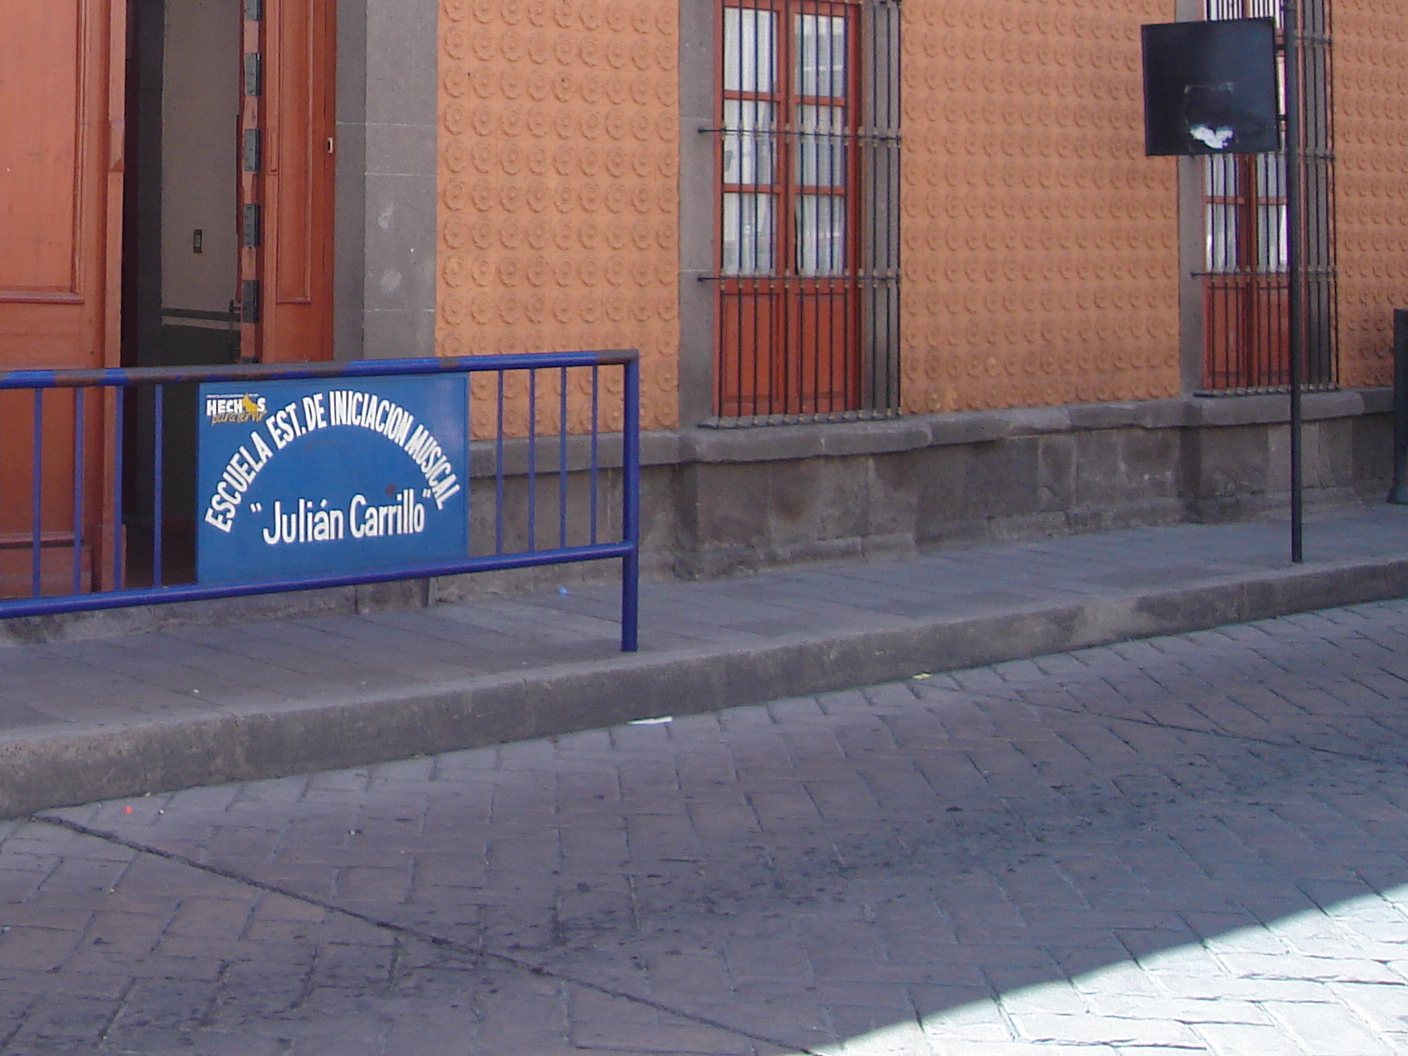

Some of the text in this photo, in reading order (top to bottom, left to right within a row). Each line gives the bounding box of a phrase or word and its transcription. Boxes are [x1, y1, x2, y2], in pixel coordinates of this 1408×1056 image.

[206, 397, 266, 416] HECHS
[204, 431, 274, 533] ESCUELA
[302, 393, 327, 430] DE
[329, 390, 414, 447] INICIACION
[404, 424, 461, 510] MUSICAL
